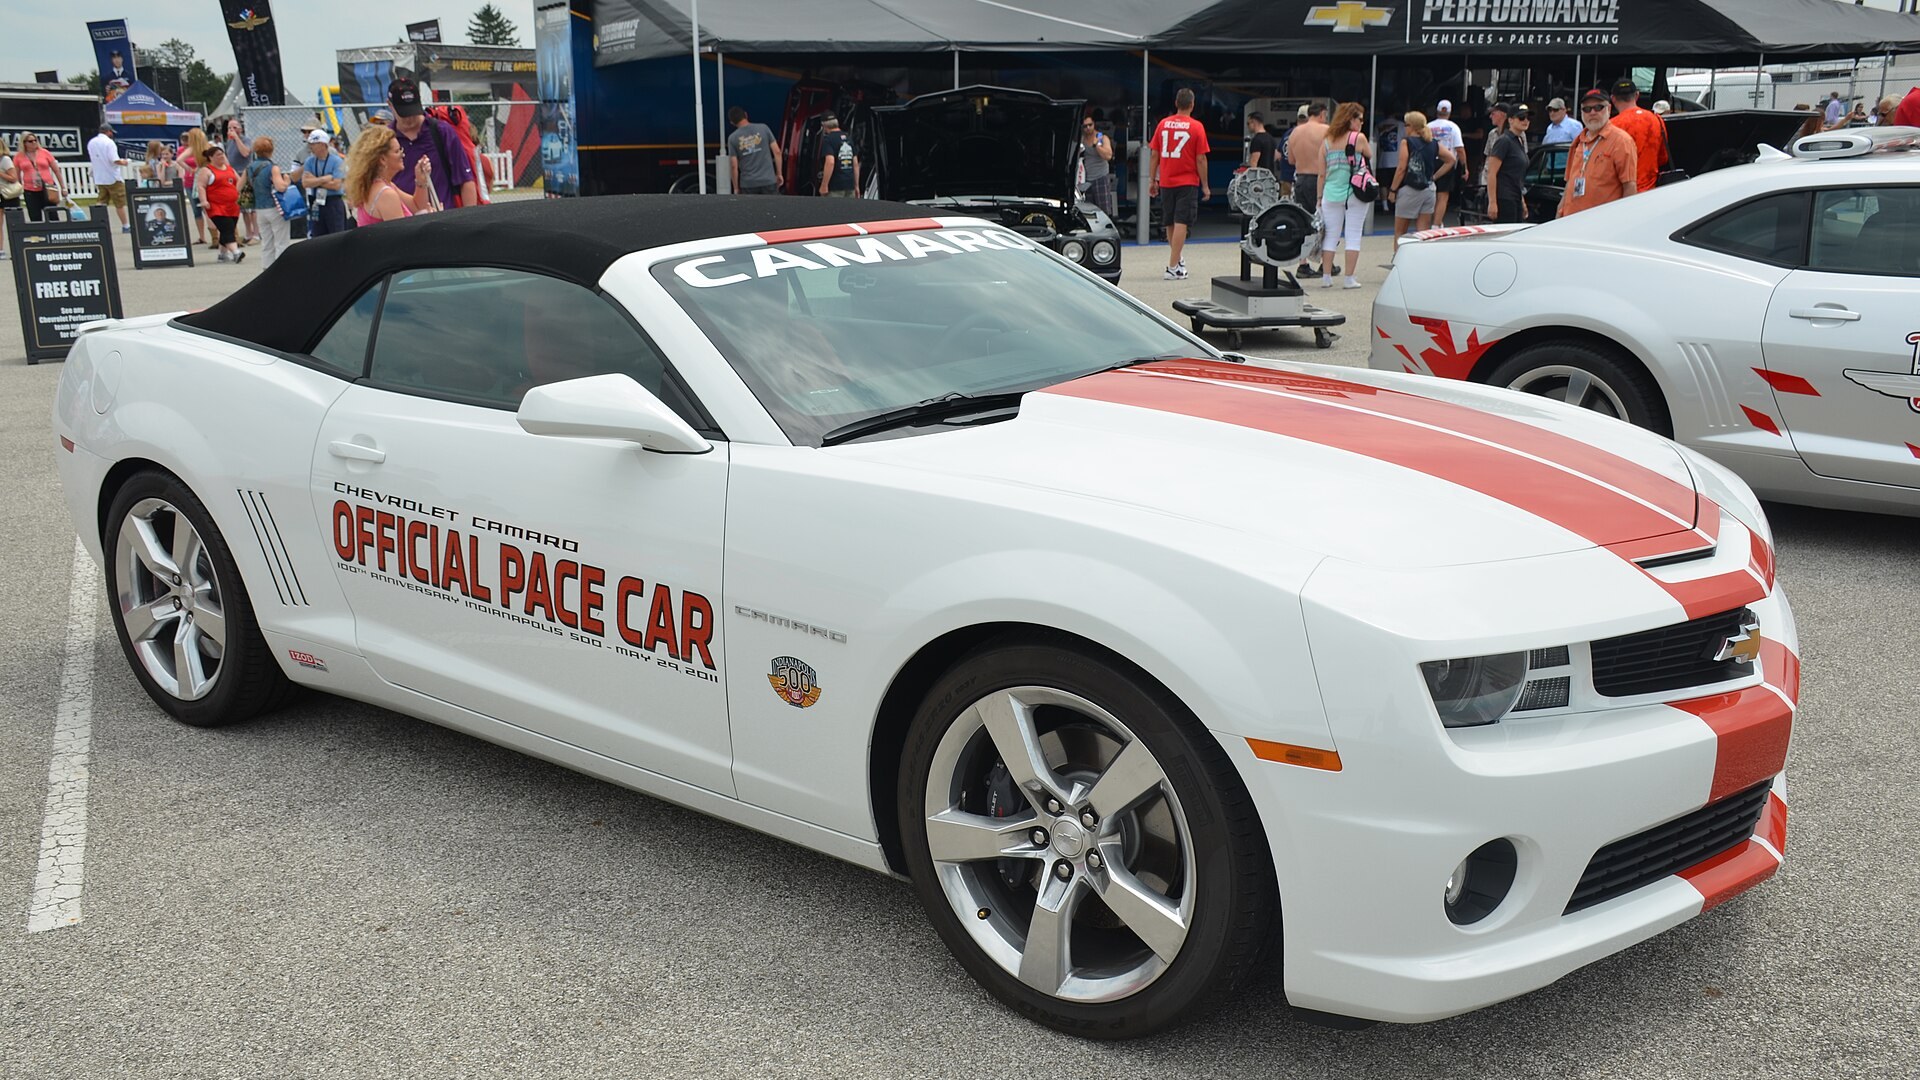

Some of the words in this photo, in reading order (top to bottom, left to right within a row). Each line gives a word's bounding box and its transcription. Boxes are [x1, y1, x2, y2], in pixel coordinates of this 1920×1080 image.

[1421, 0, 1621, 23] PERFORMANCE
[1421, 33, 1493, 45] VEHICLES
[1509, 33, 1551, 45] PARTS
[1566, 33, 1619, 45] RACING
[452, 60, 494, 71] WELCOME
[502, 61, 513, 72] THE
[1163, 120, 1190, 129] SECONDS
[1161, 129, 1191, 158] 17
[51, 232, 99, 241] PERFORMANCE
[35, 252, 72, 262] Register
[73, 251, 93, 260] here
[674, 229, 1036, 288] CAMARO
[49, 263, 62, 271] for
[63, 263, 82, 271] your
[35, 280, 70, 299] FREE
[70, 279, 100, 297] GIFT
[39, 315, 69, 324] Chevrolet
[68, 313, 107, 323] Performance
[60, 307, 72, 315] See
[73, 307, 84, 315] any
[334, 481, 459, 521] CHEVROLET
[472, 516, 579, 553] CAMARO
[333, 499, 491, 603] OFFICIAL
[500, 542, 606, 638] PACE
[616, 575, 717, 671] CAR
[337, 561, 367, 575] 100TH
[371, 571, 459, 604] ANNIVERSARY
[465, 599, 563, 636] INDIANAPOLIS
[570, 631, 602, 648] 500
[616, 646, 651, 662] MAY
[685, 666, 719, 684] 2011
[735, 605, 847, 644] CAMARO
[290, 651, 314, 663] IZOD
[778, 666, 811, 694] 500
